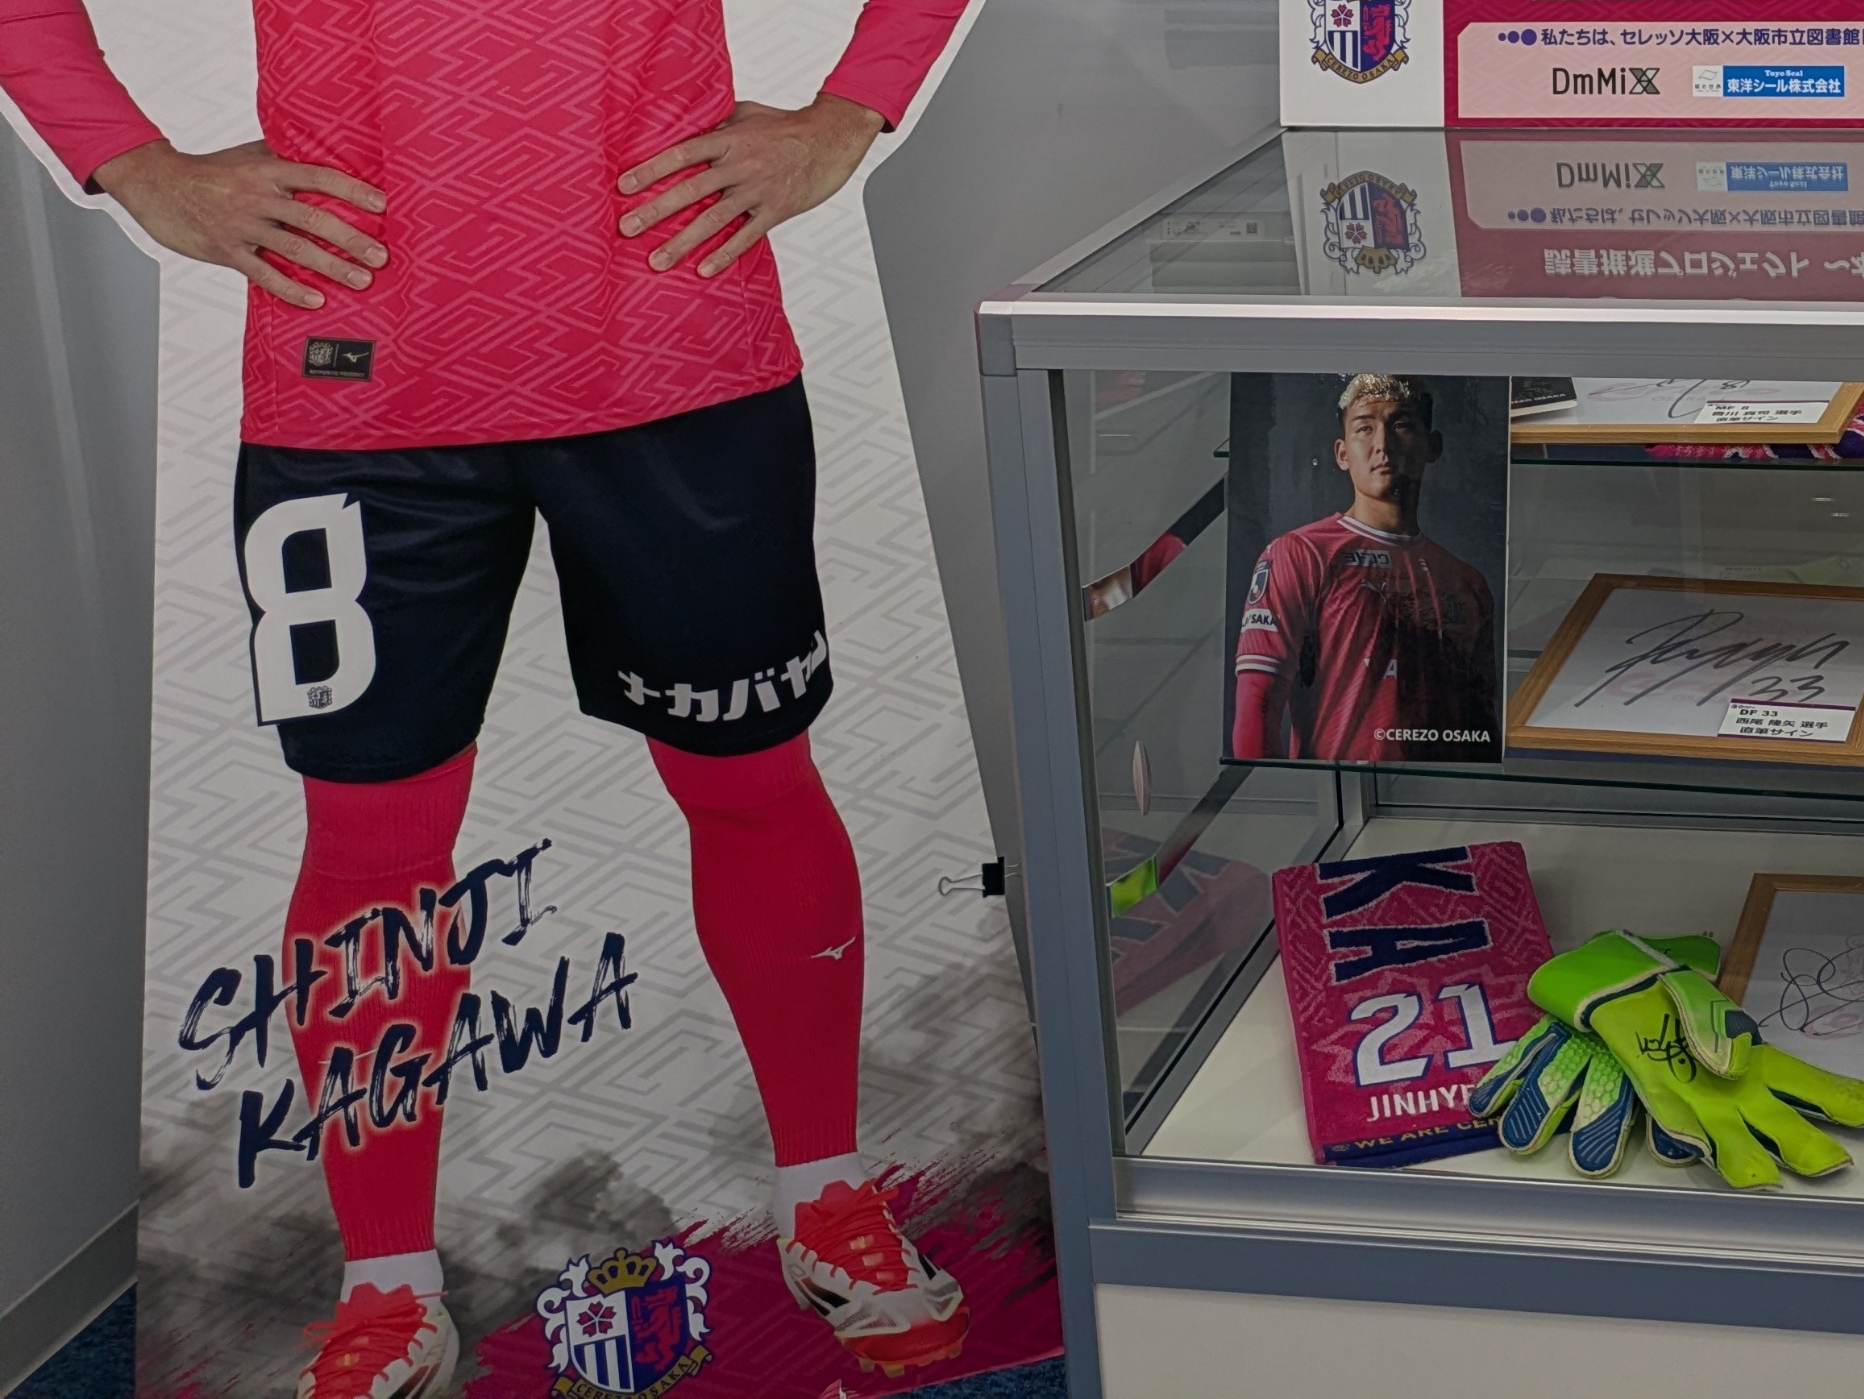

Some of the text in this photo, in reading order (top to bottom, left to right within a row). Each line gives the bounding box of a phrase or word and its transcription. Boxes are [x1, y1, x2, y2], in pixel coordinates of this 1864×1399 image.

[1327, 57, 1394, 80] CEREZO OSAKA
[1764, 69, 1804, 78] Toyo Seal
[1726, 78, 1842, 94] 東洋シール株式会社
[244, 491, 377, 727] 8
[1739, 708, 1779, 717] DF 33
[1736, 717, 1764, 726] 西尾
[1800, 720, 1829, 729] 選手
[1739, 726, 1815, 737] 直筆サイン
[1442, 728, 1491, 743] OSAKA
[179, 837, 557, 1090] SHINJI
[1349, 982, 1519, 1088] 21
[237, 932, 639, 1188] KAGAWA
[1354, 1137, 1394, 1150] WE
[1400, 1125, 1450, 1142] ARE
